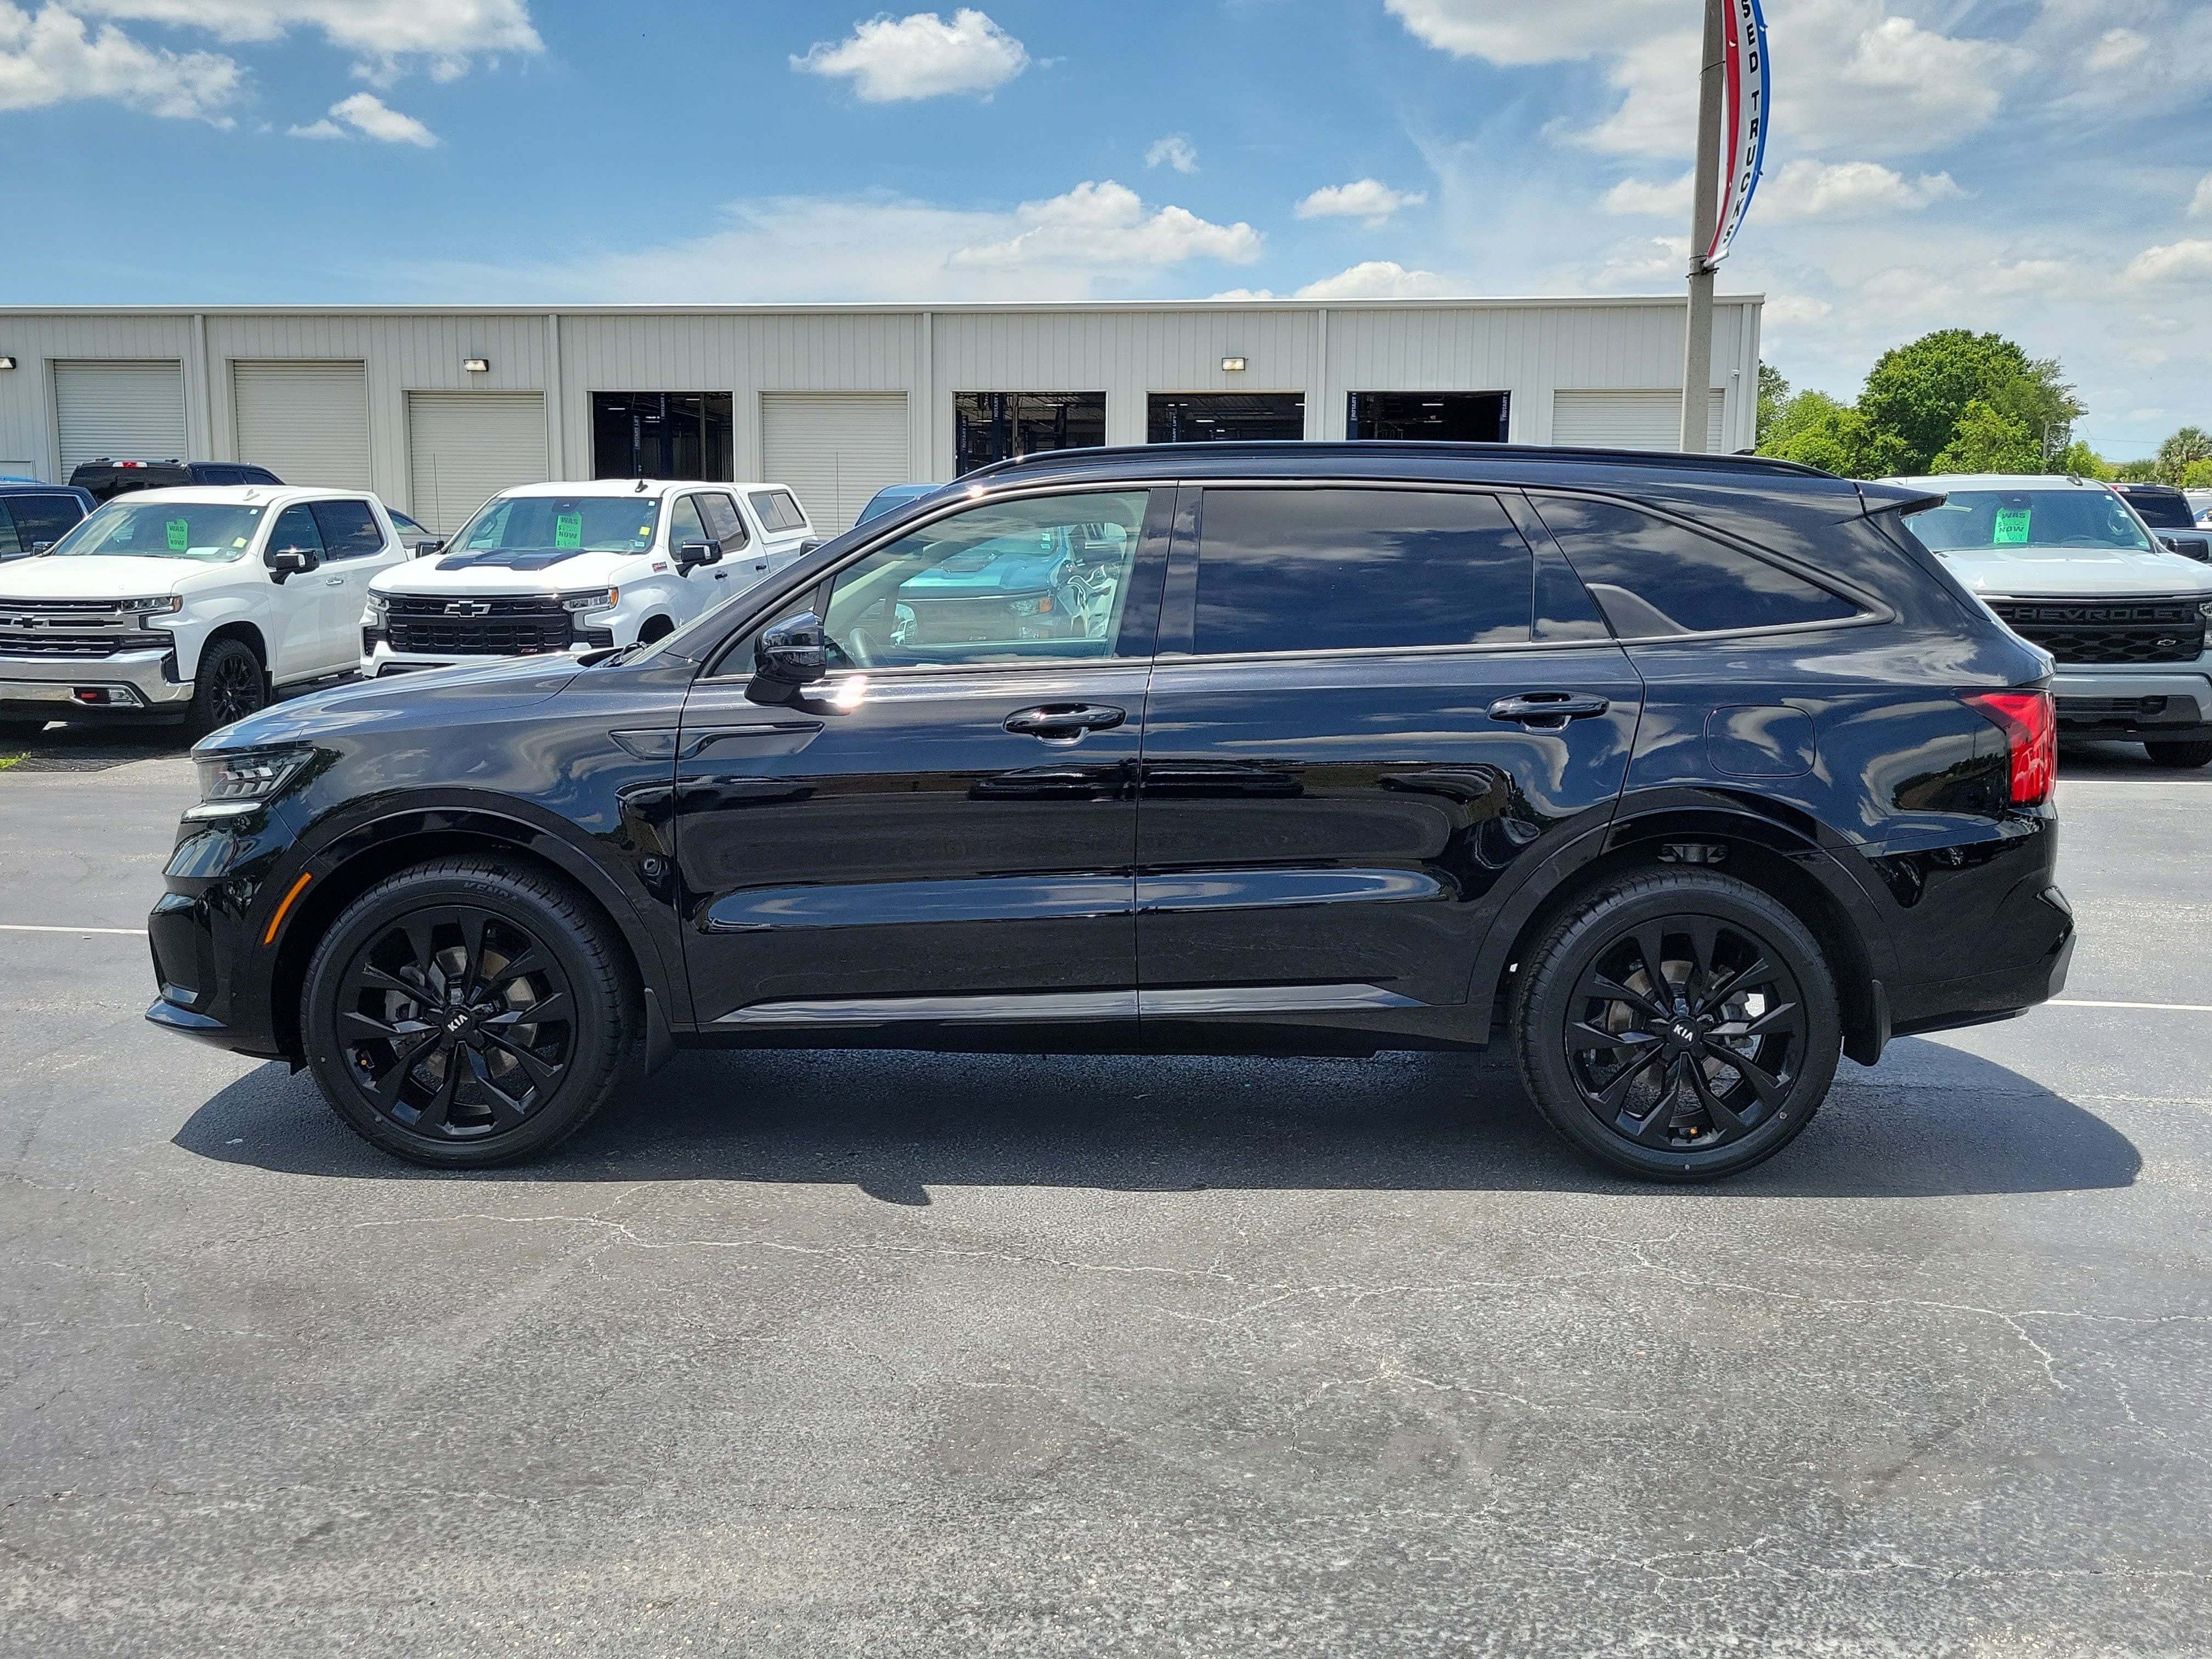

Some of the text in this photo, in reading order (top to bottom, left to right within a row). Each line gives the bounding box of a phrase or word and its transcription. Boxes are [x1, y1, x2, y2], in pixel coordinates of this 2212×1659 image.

[1723, 89, 1760, 244] TRUCKS
[561, 517, 578, 525] WAS
[1994, 607, 2194, 619] CHEVROLET
[447, 1014, 468, 1031] KIA
[1673, 1024, 1693, 1042] KIA
